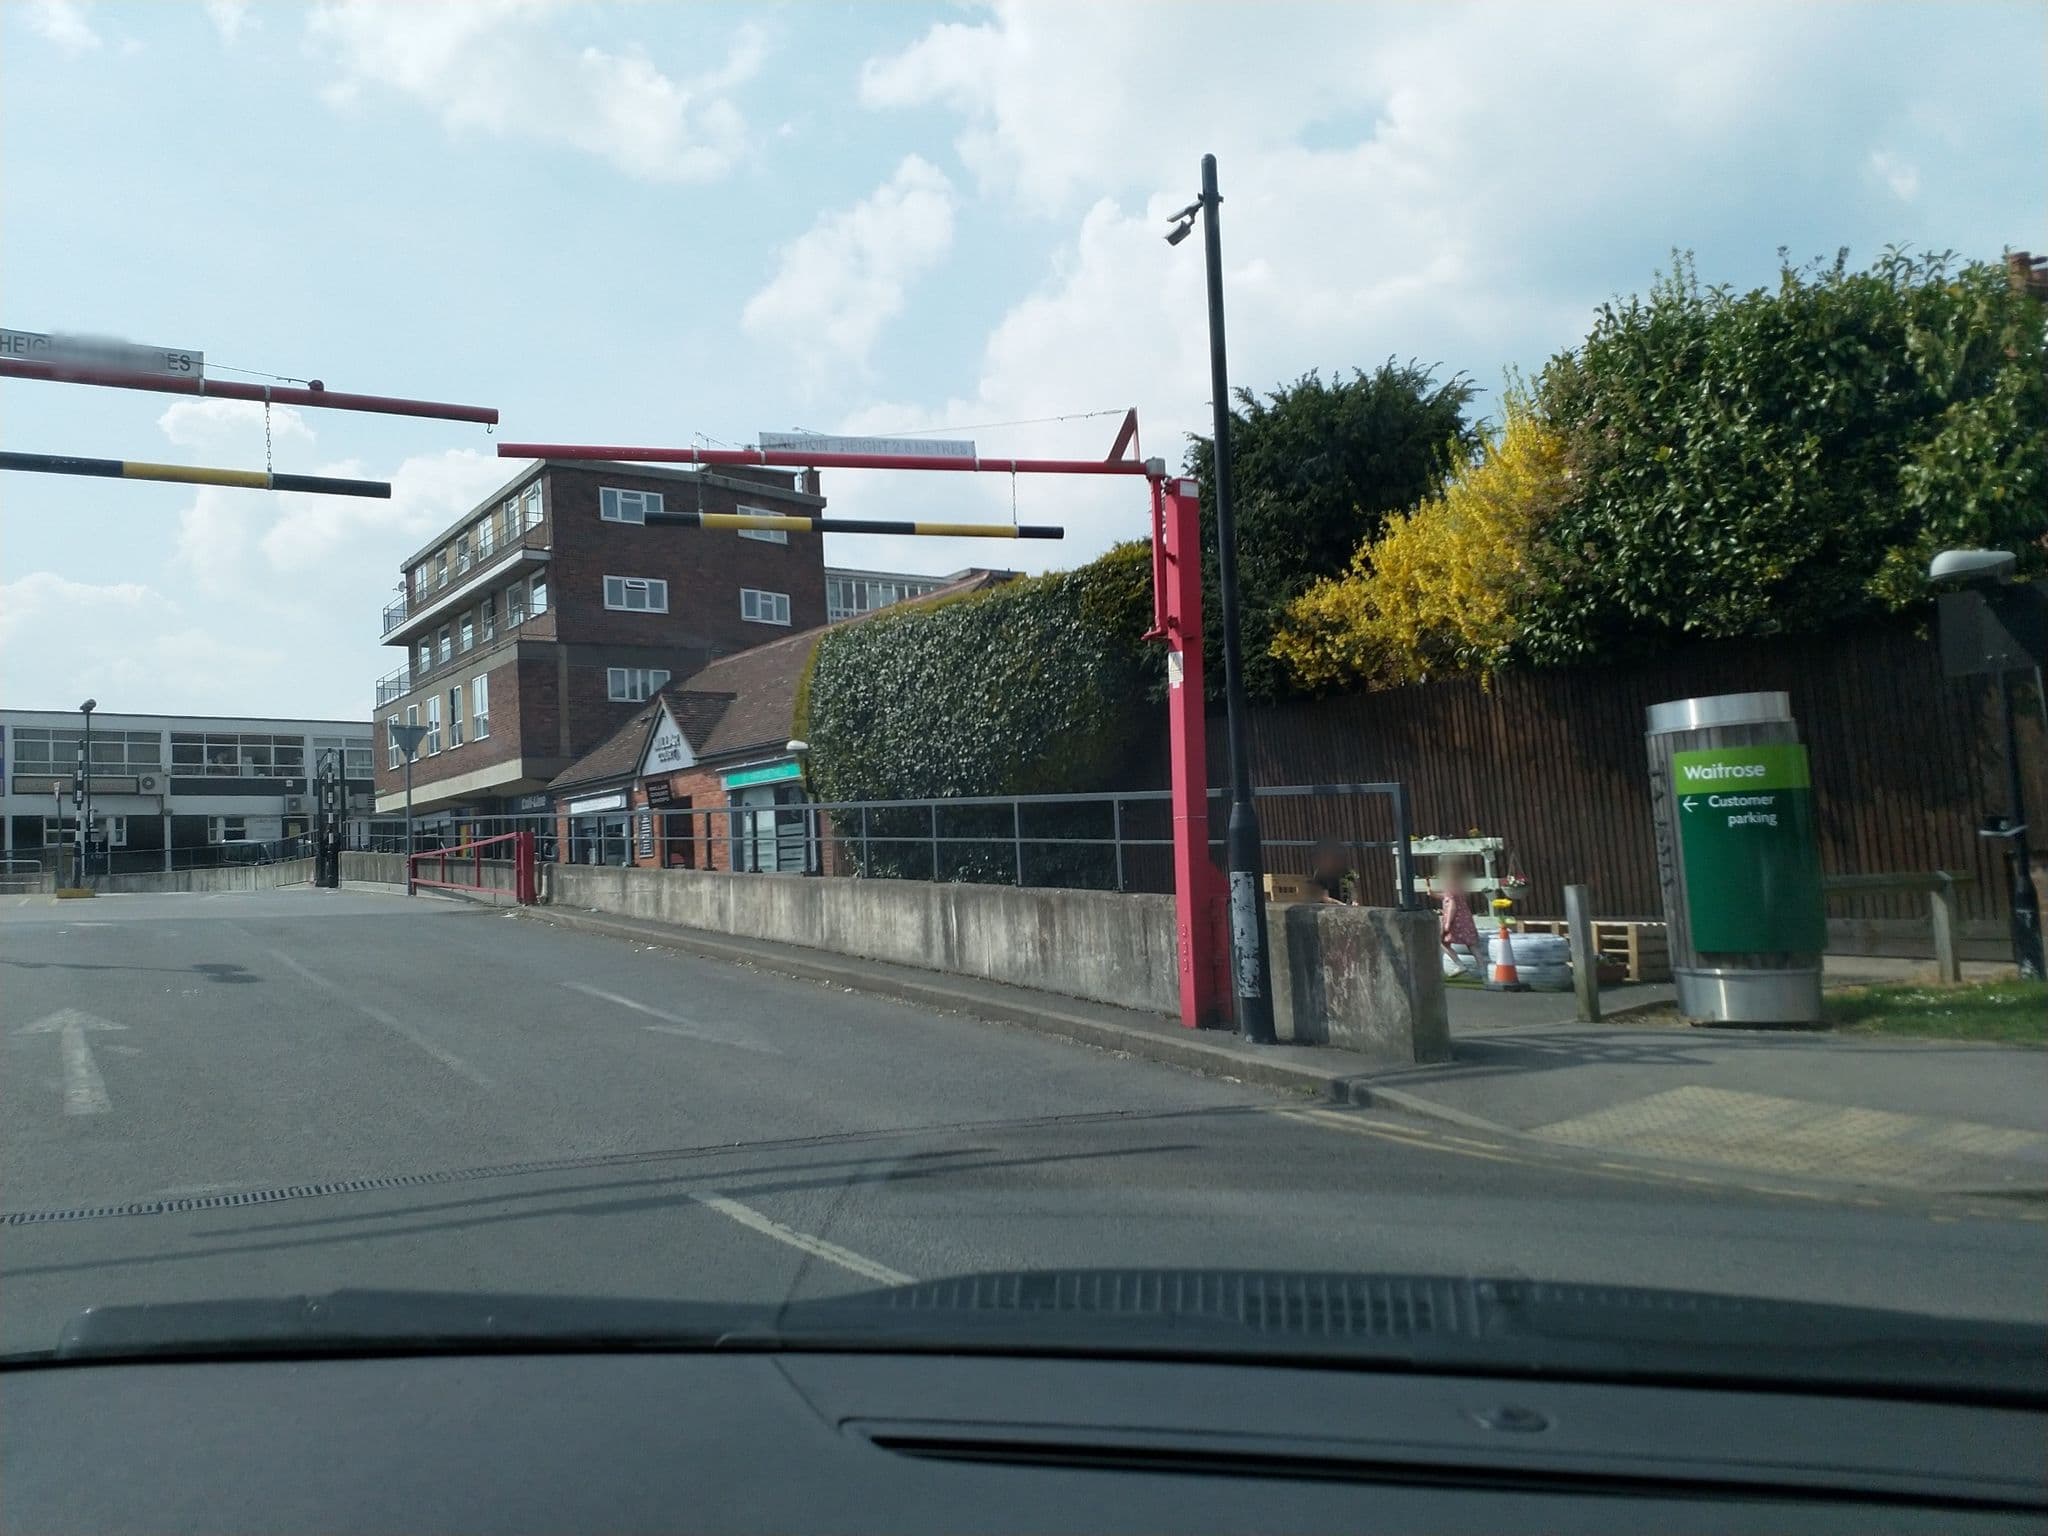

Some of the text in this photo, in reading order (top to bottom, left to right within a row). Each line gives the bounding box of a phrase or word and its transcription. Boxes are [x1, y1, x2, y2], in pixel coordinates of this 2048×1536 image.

[1683, 762, 1766, 780] Waitrose
[1708, 795, 1776, 808] Customer
[1727, 811, 1778, 827] parking
